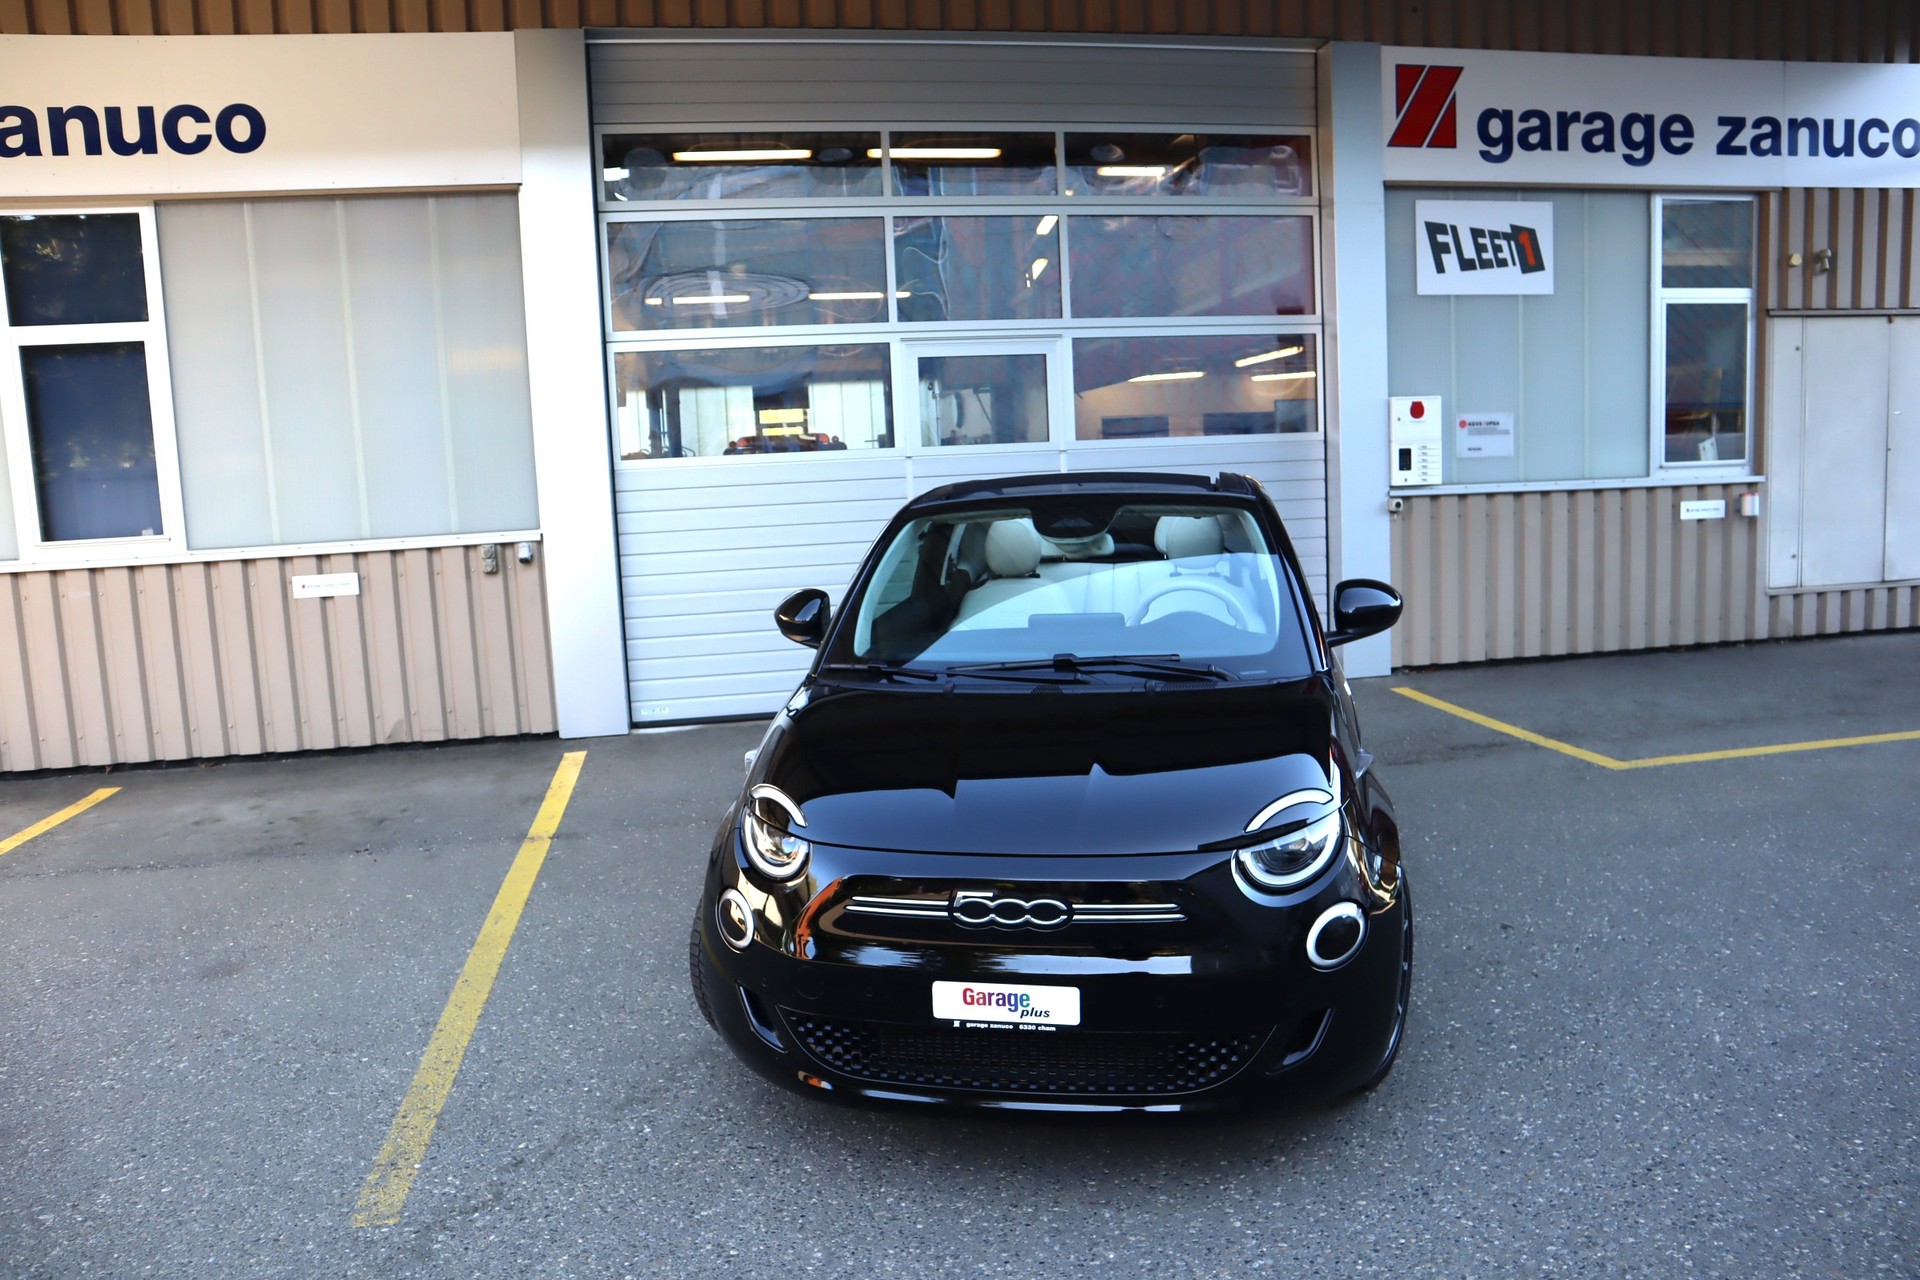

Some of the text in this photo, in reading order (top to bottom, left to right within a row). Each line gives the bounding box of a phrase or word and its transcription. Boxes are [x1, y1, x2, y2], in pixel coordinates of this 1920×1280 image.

[0, 103, 266, 158] anuco
[1477, 107, 1920, 167] garage zanuco
[953, 891, 1068, 925] 500
[962, 988, 1031, 1012] Garage
[1020, 1007, 1050, 1019] plus
